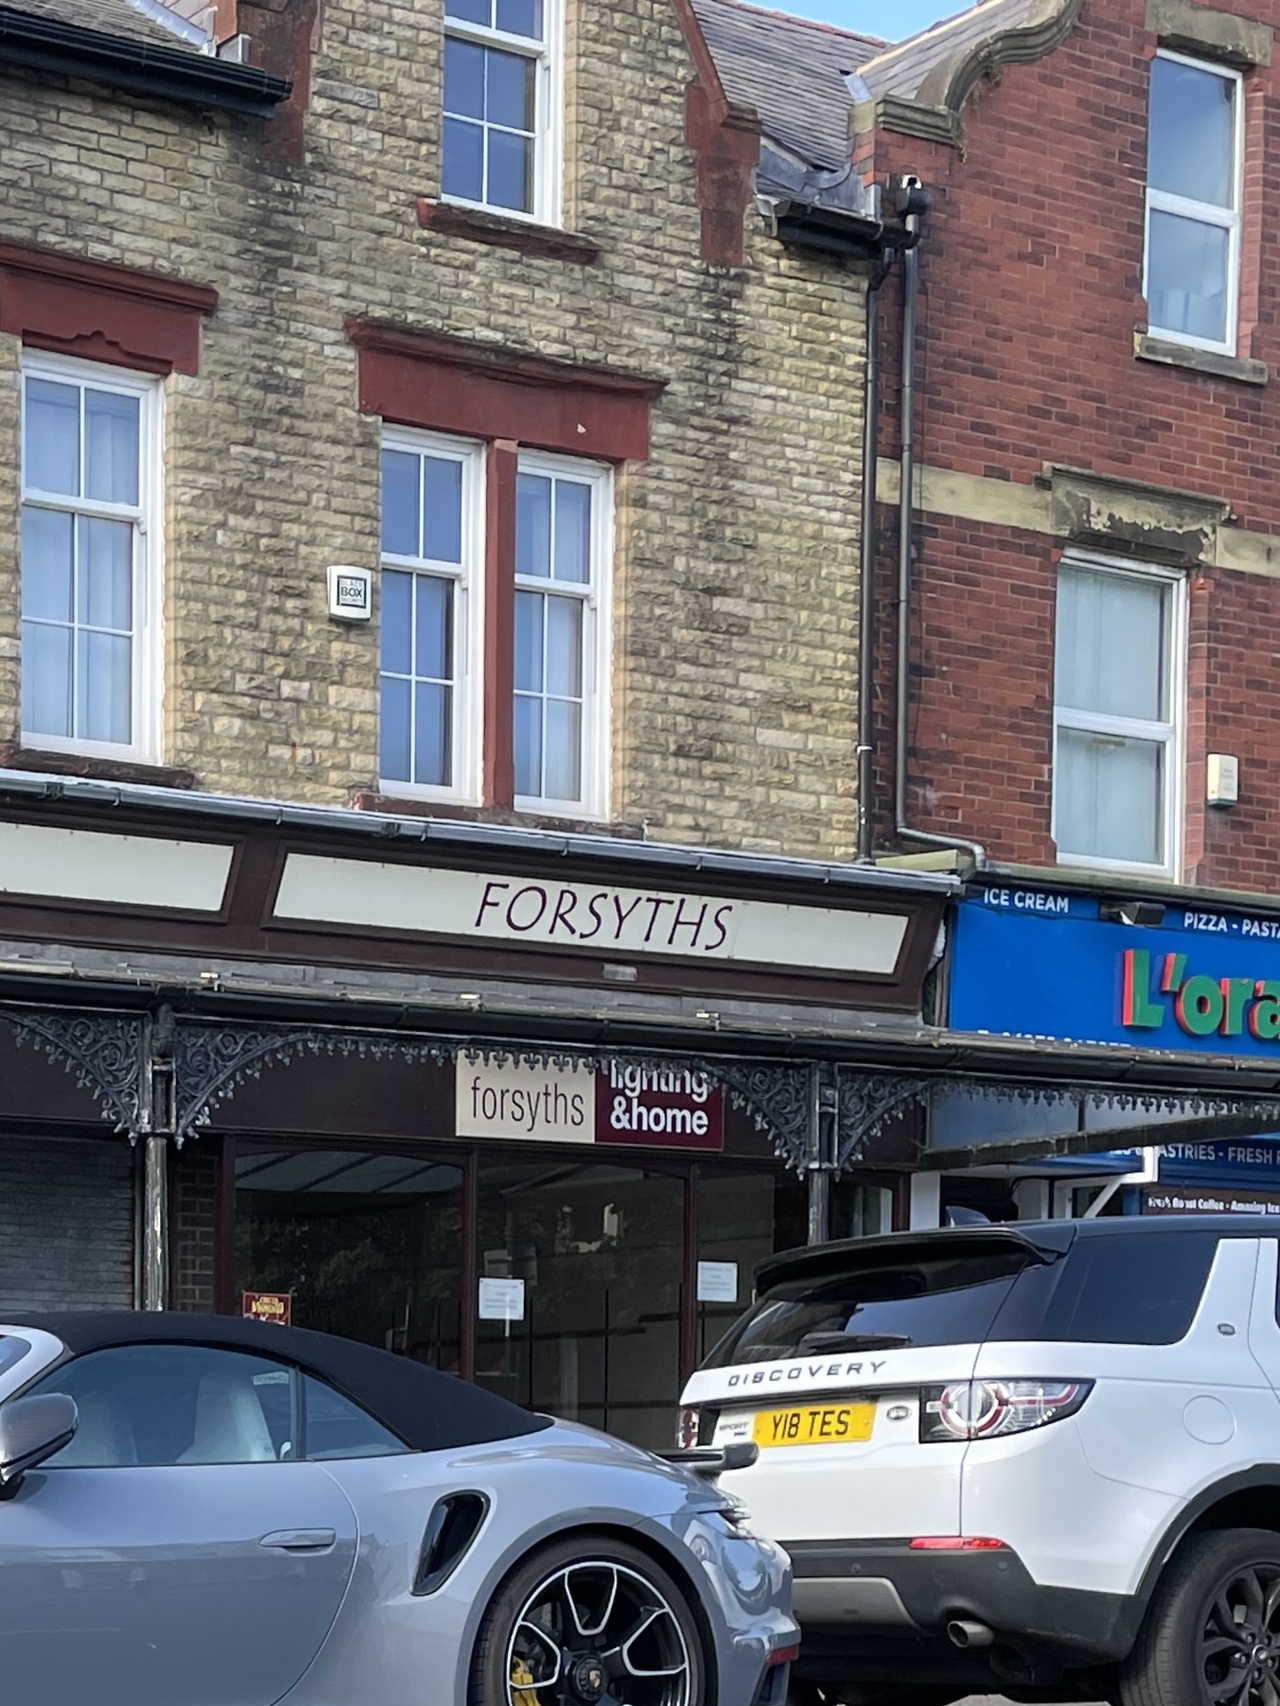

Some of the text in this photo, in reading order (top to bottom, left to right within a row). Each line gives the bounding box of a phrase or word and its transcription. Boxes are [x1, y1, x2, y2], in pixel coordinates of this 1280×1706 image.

[340, 587, 363, 598] BOX
[984, 888, 1069, 913] ICE CREAM
[474, 882, 733, 951] FORSYTHS
[1184, 912, 1228, 933] PIZZA
[471, 1076, 584, 1132] forsyths
[610, 1095, 708, 1135] &home
[1228, 1146, 1273, 1165] FRESH
[1198, 1198, 1224, 1210] Coffee
[1230, 1200, 1266, 1215] Amazing
[727, 1360, 887, 1387] DISCOVERY
[772, 1409, 851, 1440] Y18 TES
